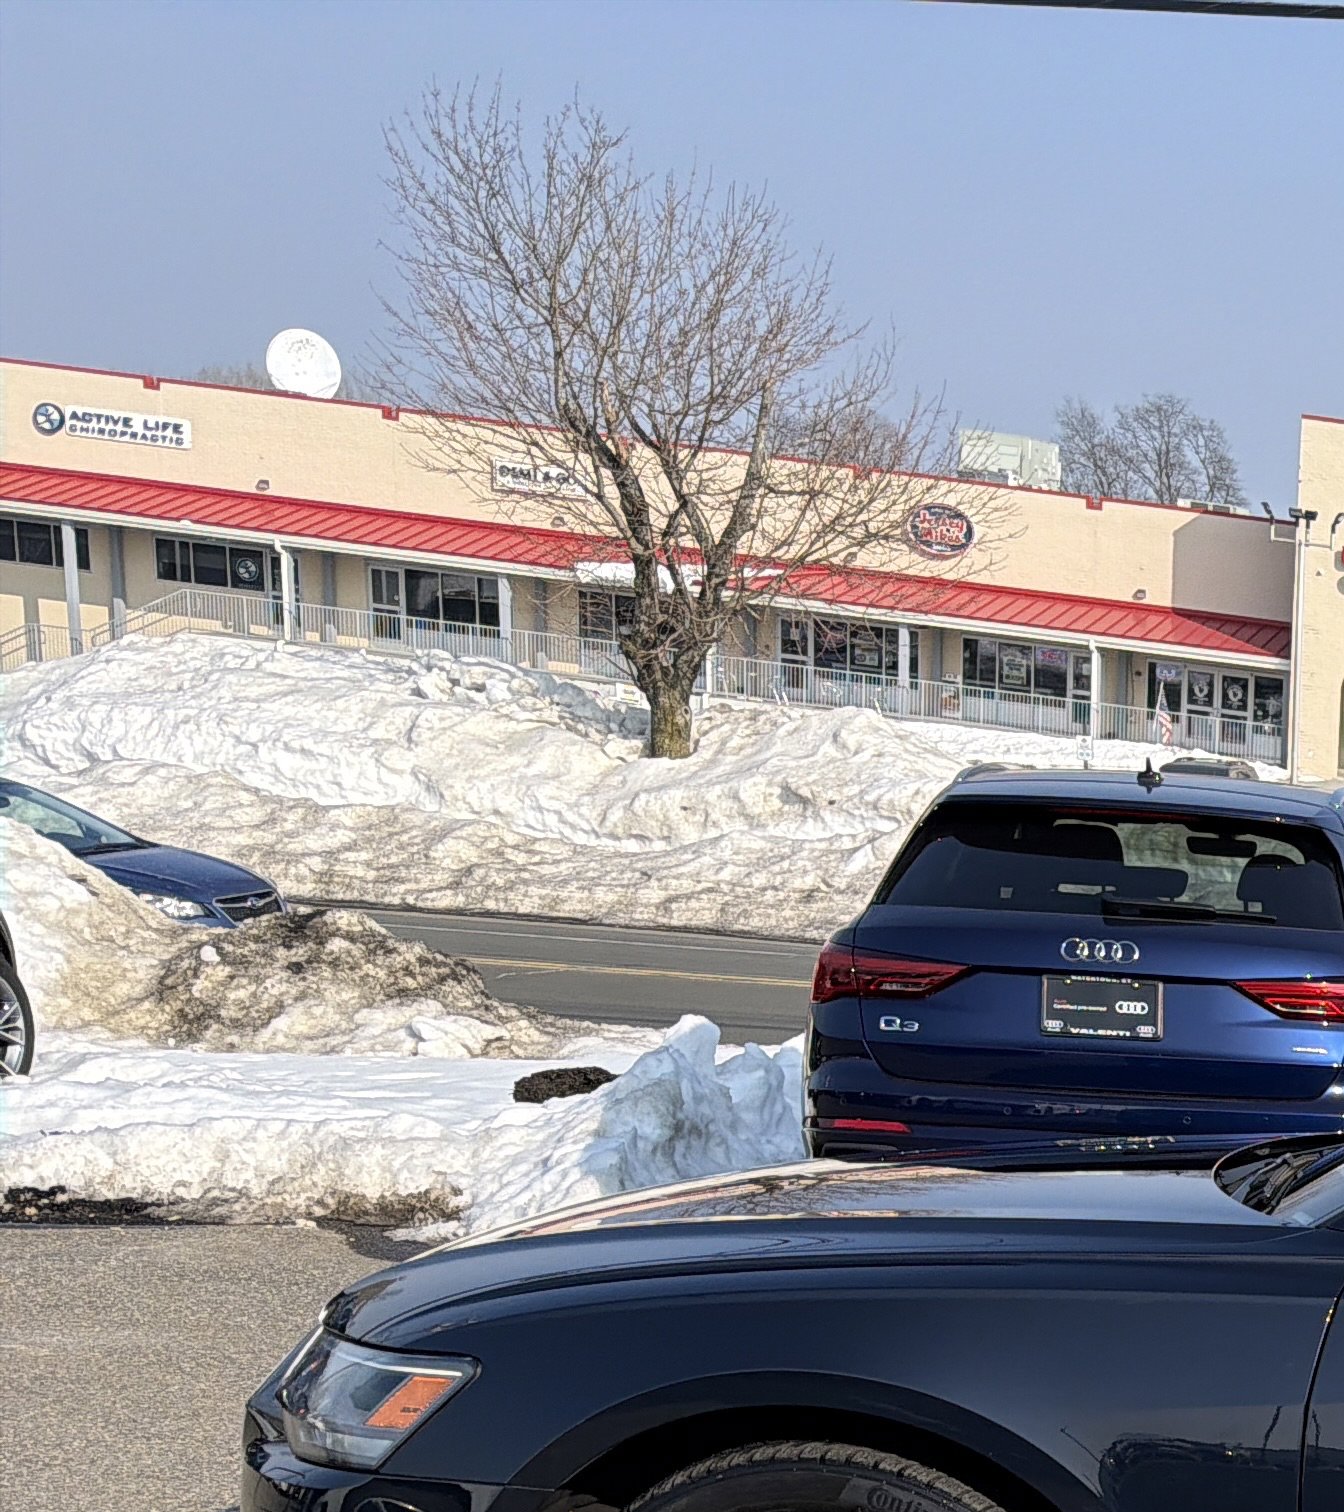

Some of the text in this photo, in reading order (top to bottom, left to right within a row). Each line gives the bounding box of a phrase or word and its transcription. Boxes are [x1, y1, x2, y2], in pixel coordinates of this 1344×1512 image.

[68, 410, 185, 436] ACTIVE LIFE
[68, 423, 185, 447] CHIROPRACTIC
[918, 511, 965, 534] Jersey
[879, 1015, 920, 1032] Q3
[1069, 1027, 1131, 1037] VALENTI
